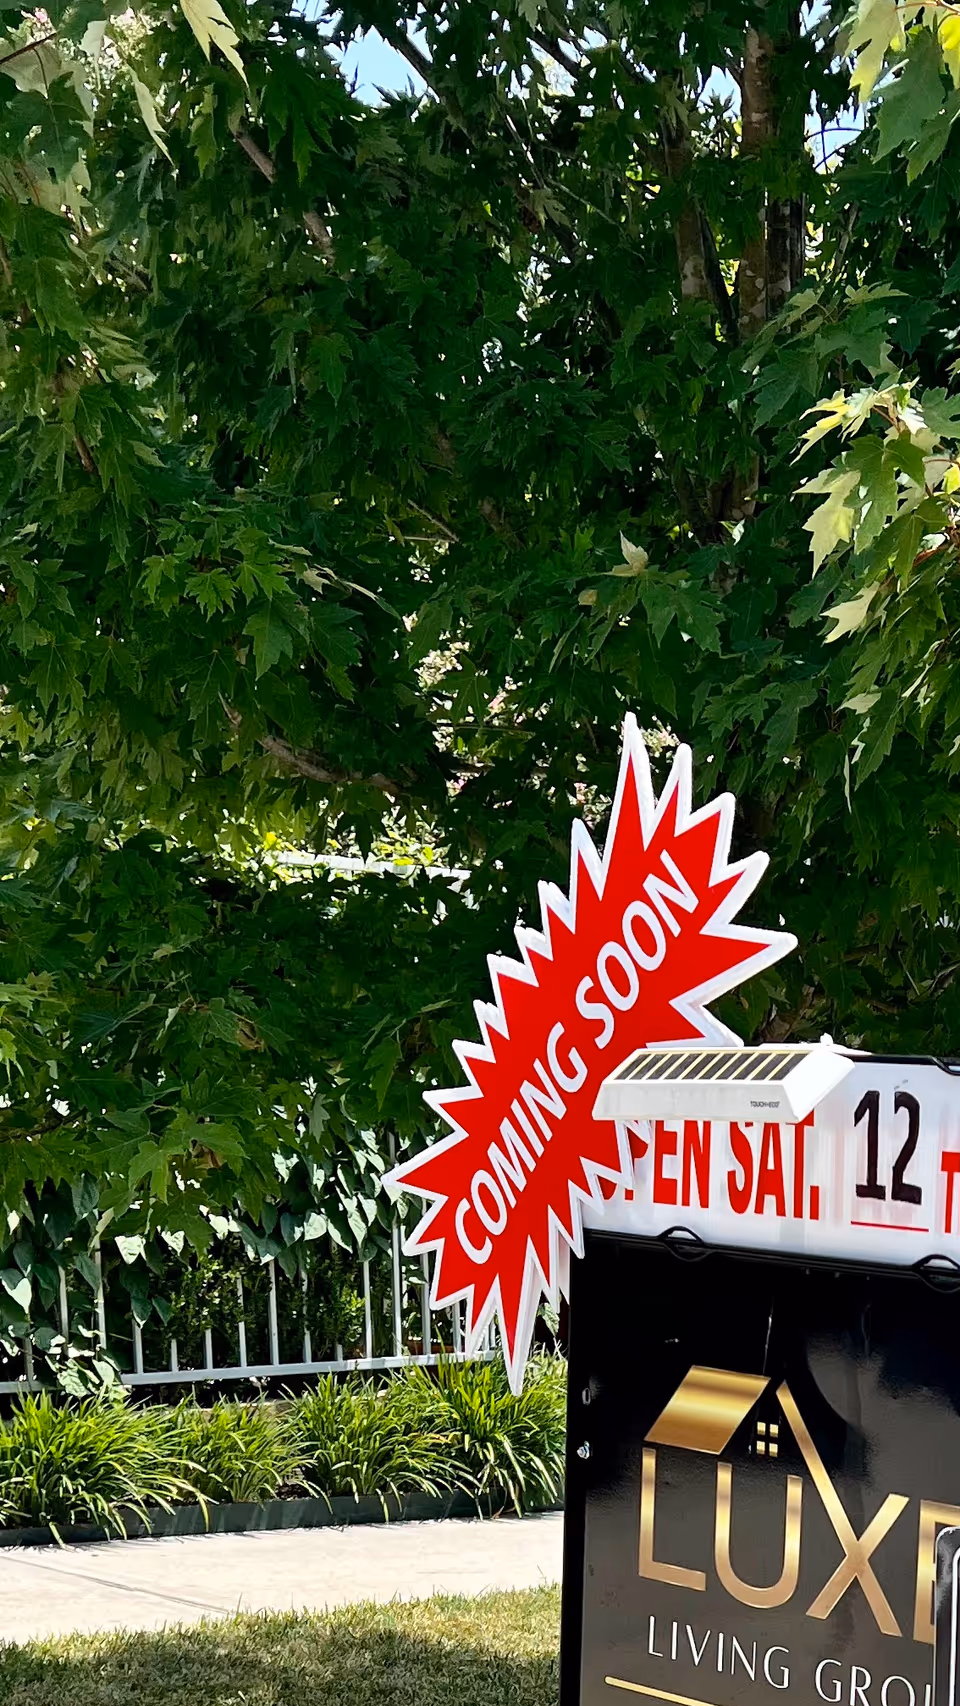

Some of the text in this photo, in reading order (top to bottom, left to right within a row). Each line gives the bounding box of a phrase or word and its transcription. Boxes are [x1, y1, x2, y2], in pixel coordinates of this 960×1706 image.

[455, 849, 699, 1265] COMING SOON
[597, 1120, 711, 1208] EN
[727, 1109, 819, 1220] SAT.
[853, 1090, 922, 1205] 12
[647, 1616, 790, 1689] LIVING
